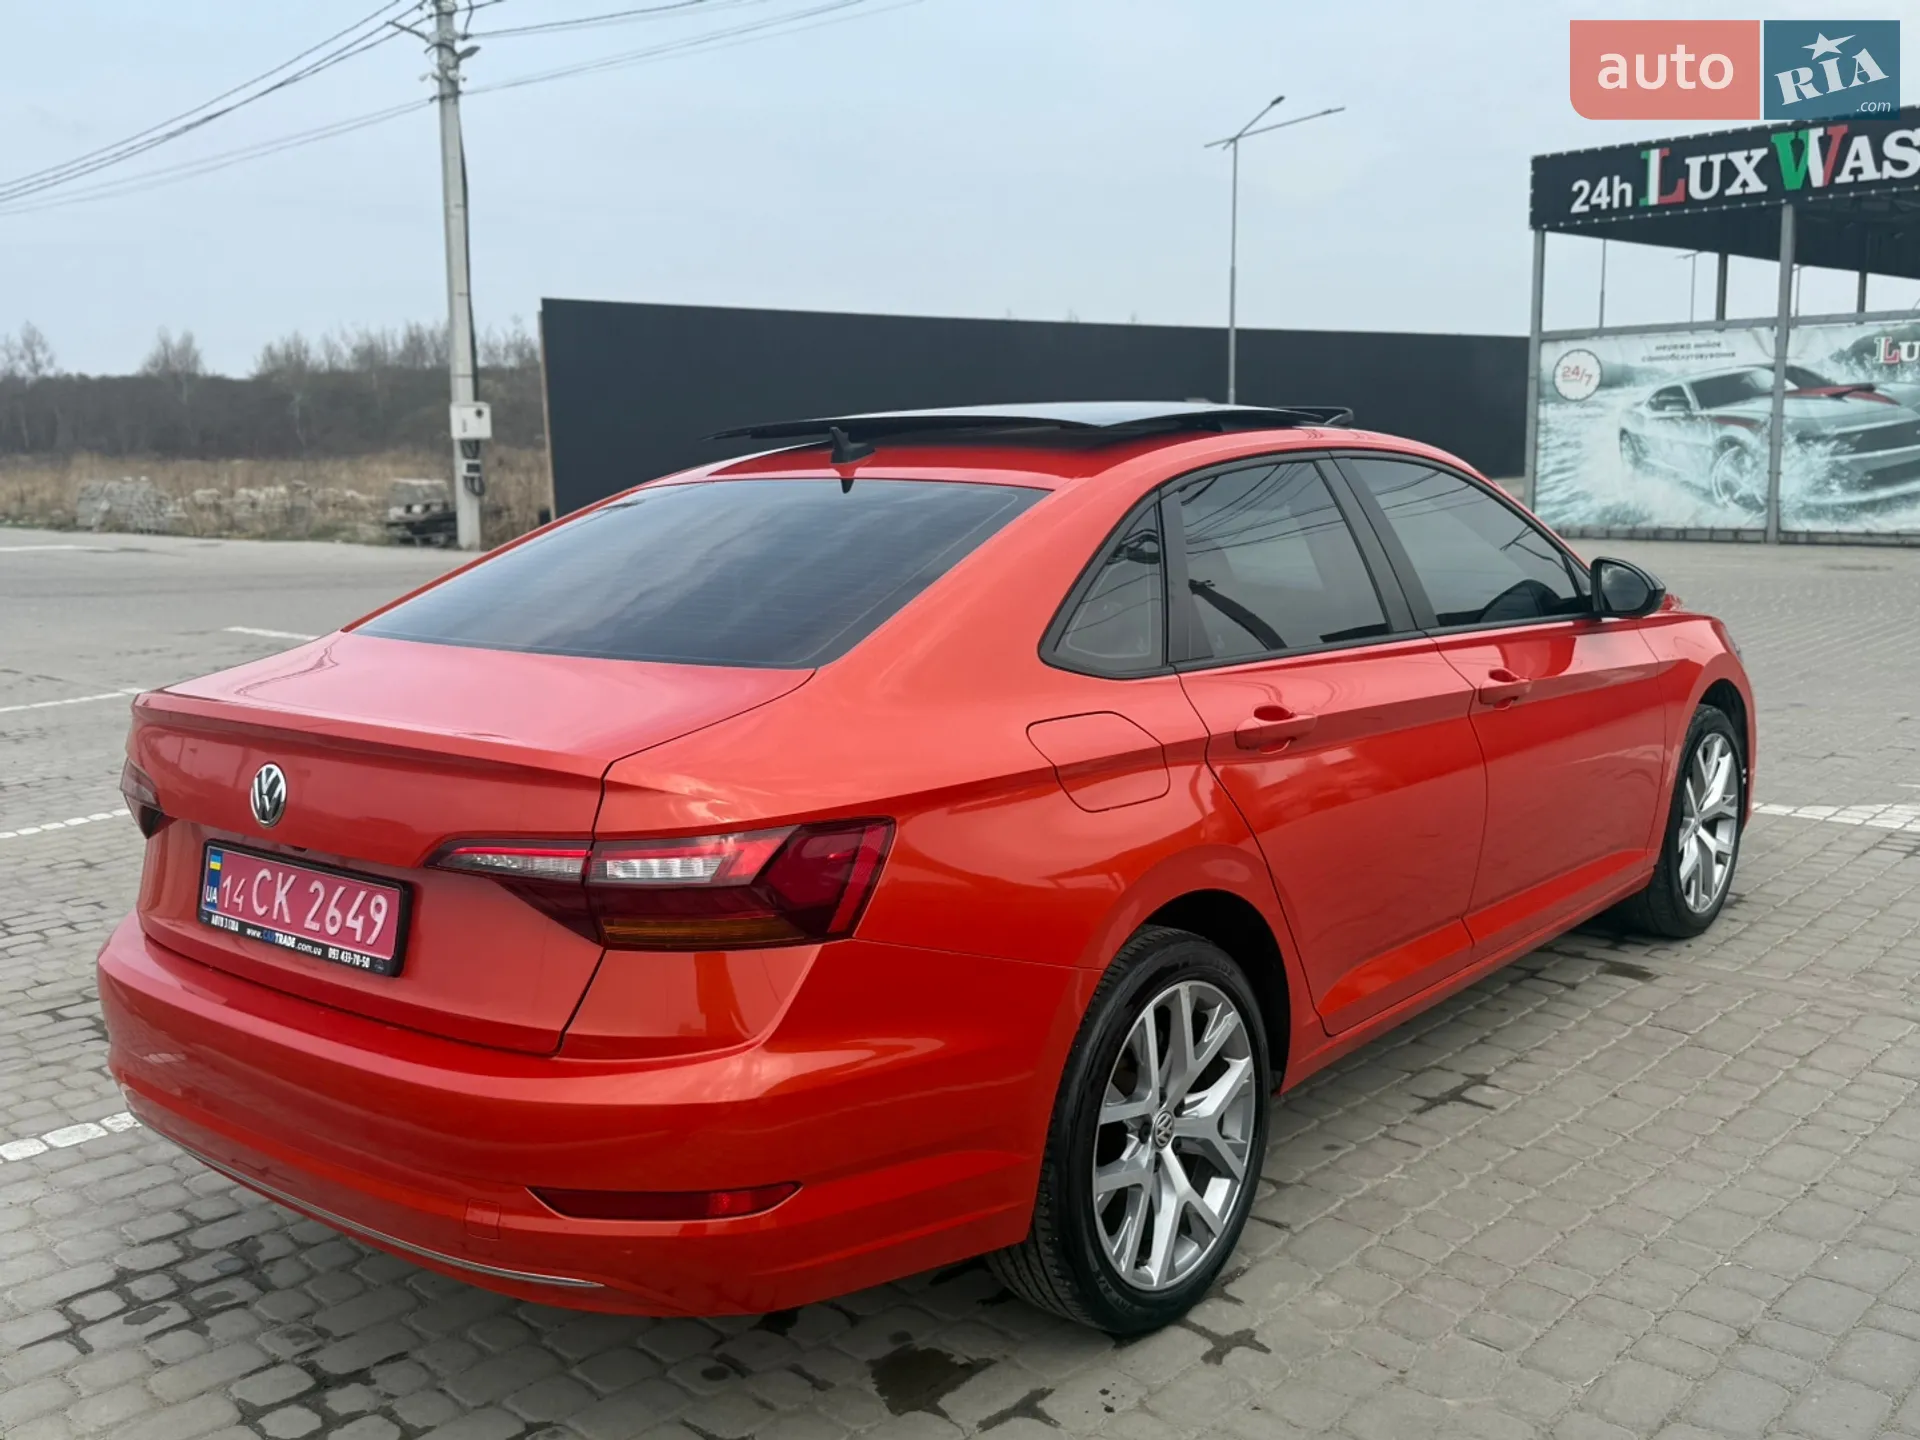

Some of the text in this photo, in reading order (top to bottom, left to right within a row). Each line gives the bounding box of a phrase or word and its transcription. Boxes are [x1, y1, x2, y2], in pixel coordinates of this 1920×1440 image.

[1571, 176, 1632, 214] 24h
[1562, 365, 1592, 387] 24/7
[205, 885, 217, 904] UA
[304, 880, 388, 945] 2649
